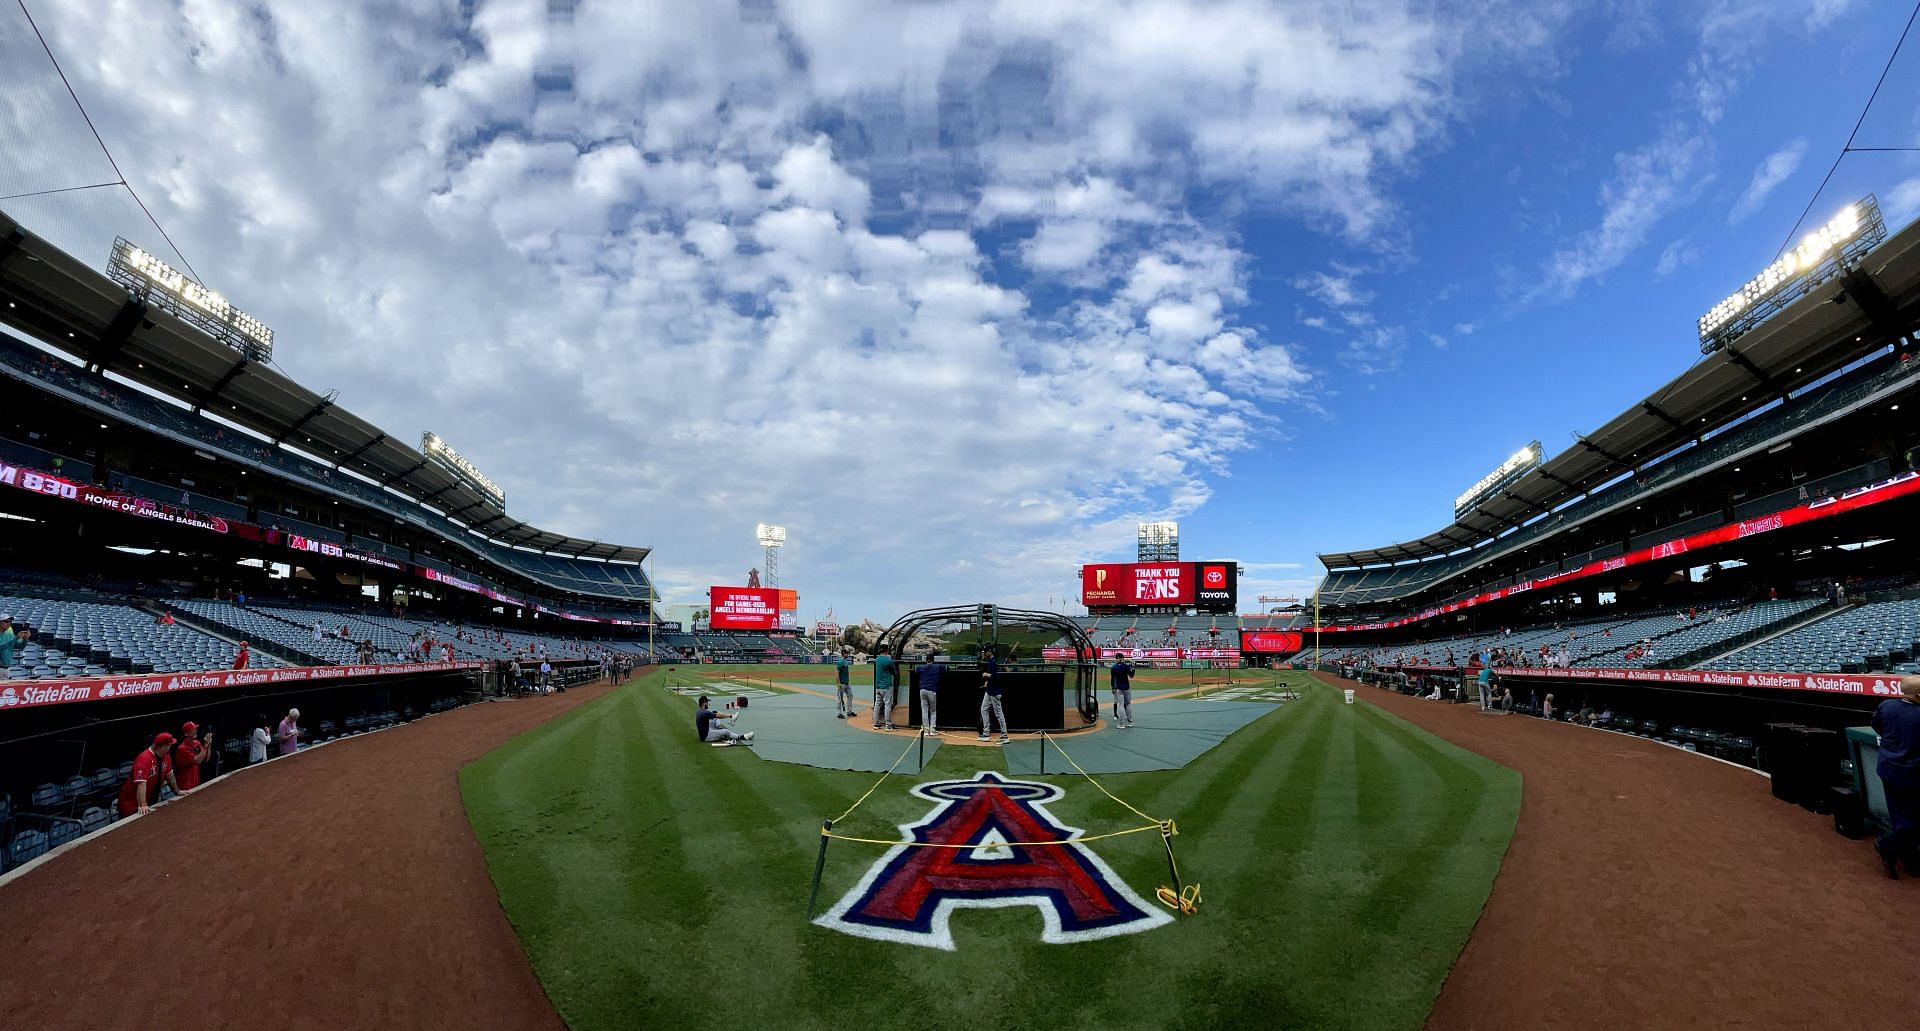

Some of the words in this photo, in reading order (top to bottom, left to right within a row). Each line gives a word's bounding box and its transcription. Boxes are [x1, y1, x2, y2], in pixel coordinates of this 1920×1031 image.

[23, 472, 77, 499] 830
[85, 493, 119, 508] HOME
[122, 503, 137, 512] OF
[138, 507, 174, 521] ANGELS
[176, 516, 215, 530] BASEBALL
[1739, 515, 1783, 538] ANGELS
[1135, 569, 1161, 577] THANK
[1164, 568, 1179, 577] YOU
[1136, 577, 1179, 599] FANS
